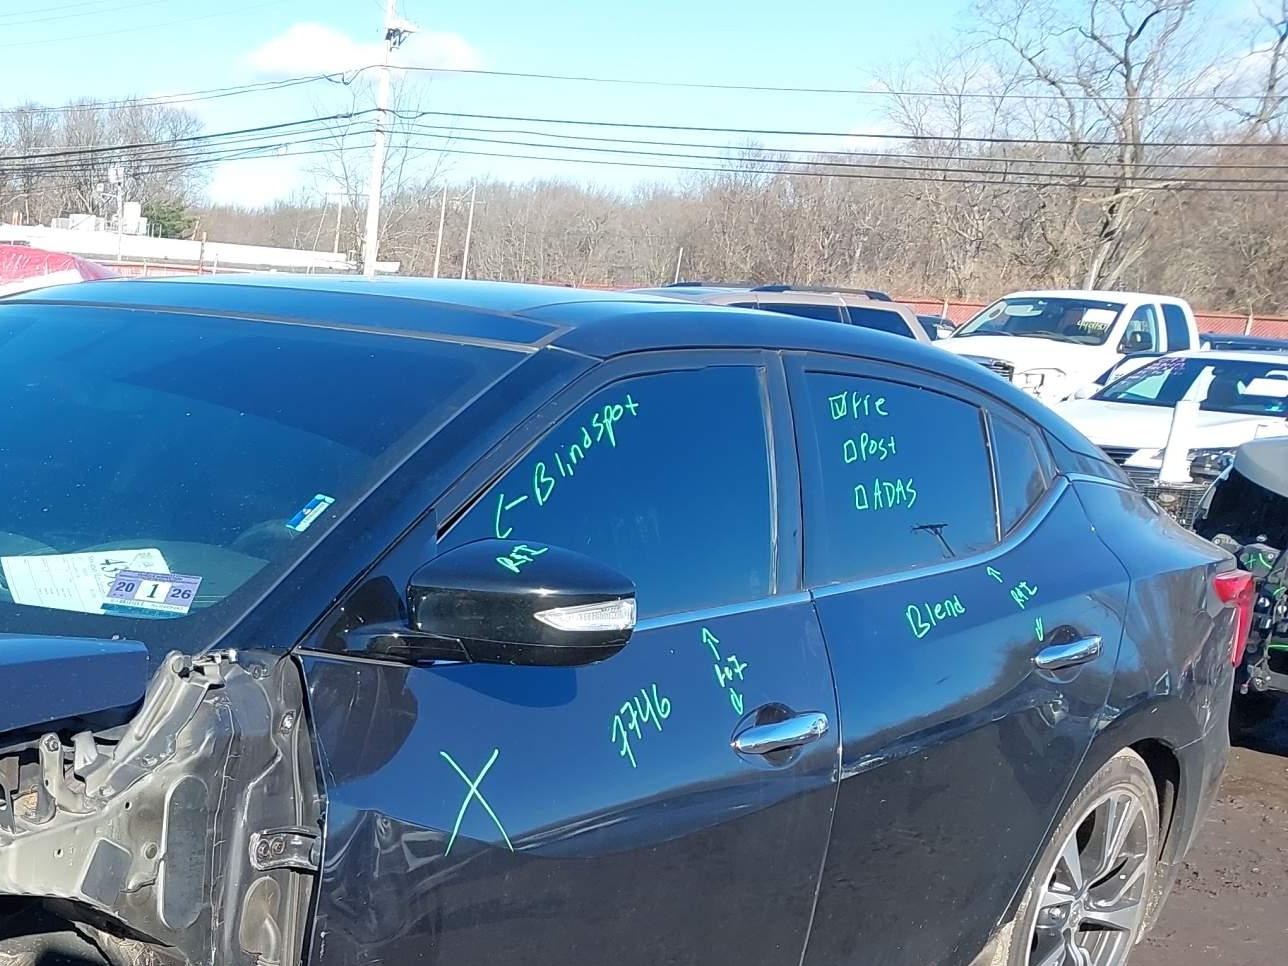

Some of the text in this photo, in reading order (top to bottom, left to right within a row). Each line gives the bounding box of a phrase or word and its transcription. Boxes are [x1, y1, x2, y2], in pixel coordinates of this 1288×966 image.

[852, 391, 889, 419] Pre
[534, 394, 639, 506] Blindspot
[860, 432, 896, 461] Post
[873, 478, 917, 510] ADAS
[114, 581, 193, 600] 20 1 26
[905, 594, 966, 639] Blend
